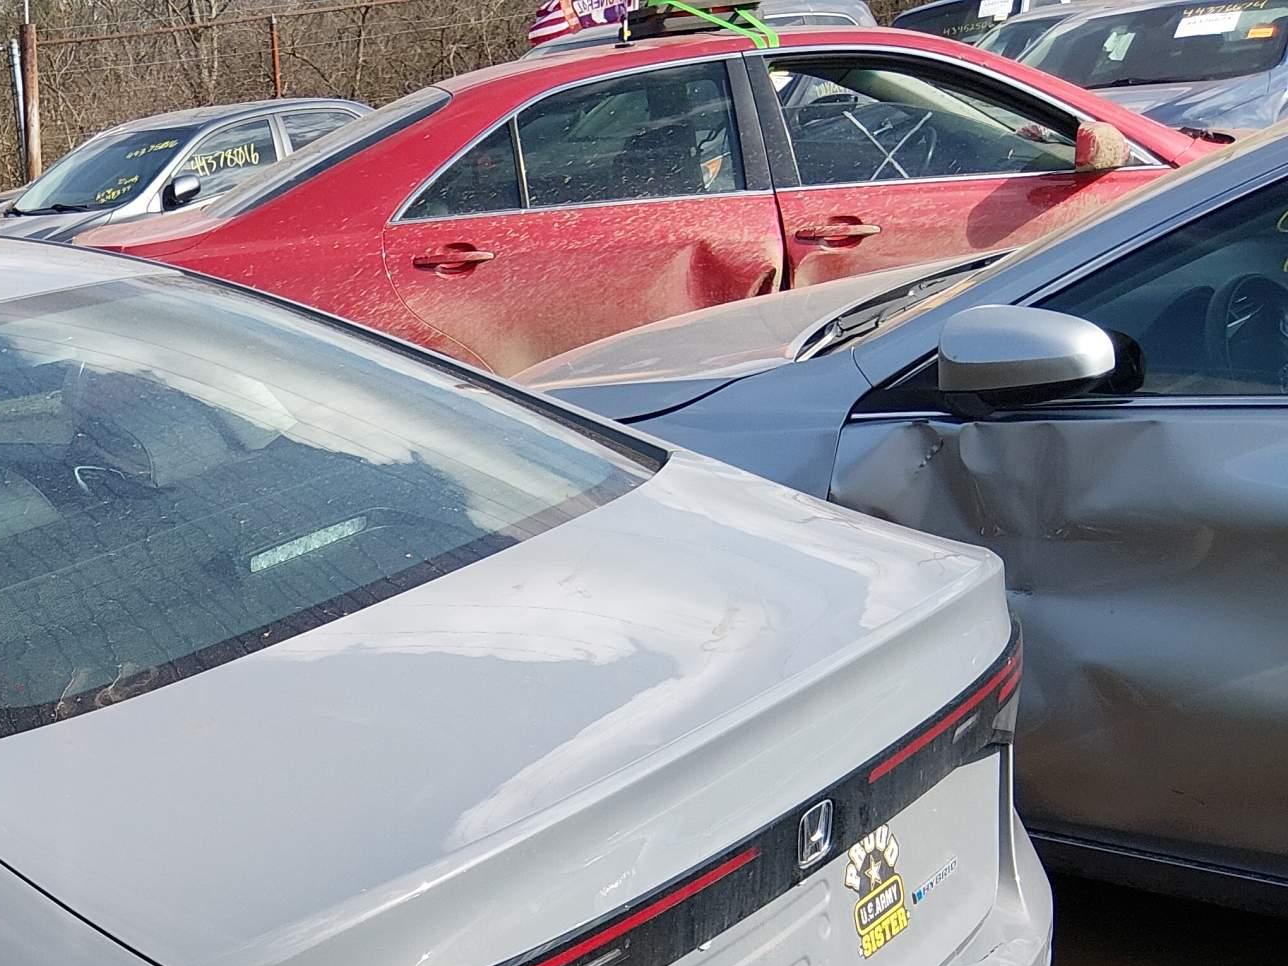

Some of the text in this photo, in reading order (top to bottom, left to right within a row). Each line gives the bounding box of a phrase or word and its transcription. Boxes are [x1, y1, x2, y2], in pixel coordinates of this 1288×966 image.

[191, 143, 260, 176] 44378016
[845, 824, 899, 893] PROUD
[922, 859, 957, 896] HYBRID
[862, 907, 908, 957] SISTER
